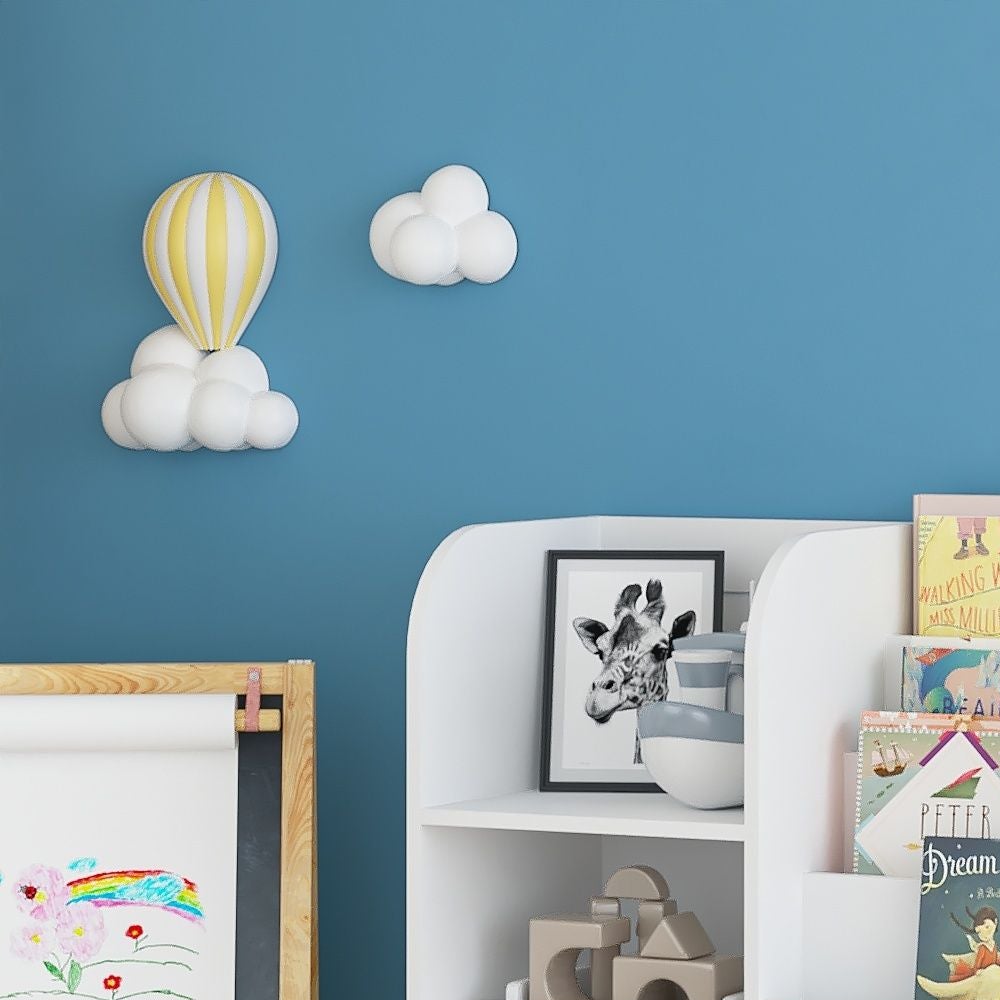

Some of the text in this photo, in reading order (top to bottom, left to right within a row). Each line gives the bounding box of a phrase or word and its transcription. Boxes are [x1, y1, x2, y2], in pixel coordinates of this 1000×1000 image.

[919, 564, 985, 603] WALKING
[929, 607, 955, 625] MISS
[920, 802, 991, 840] PETER
[920, 841, 1000, 896] Dream
